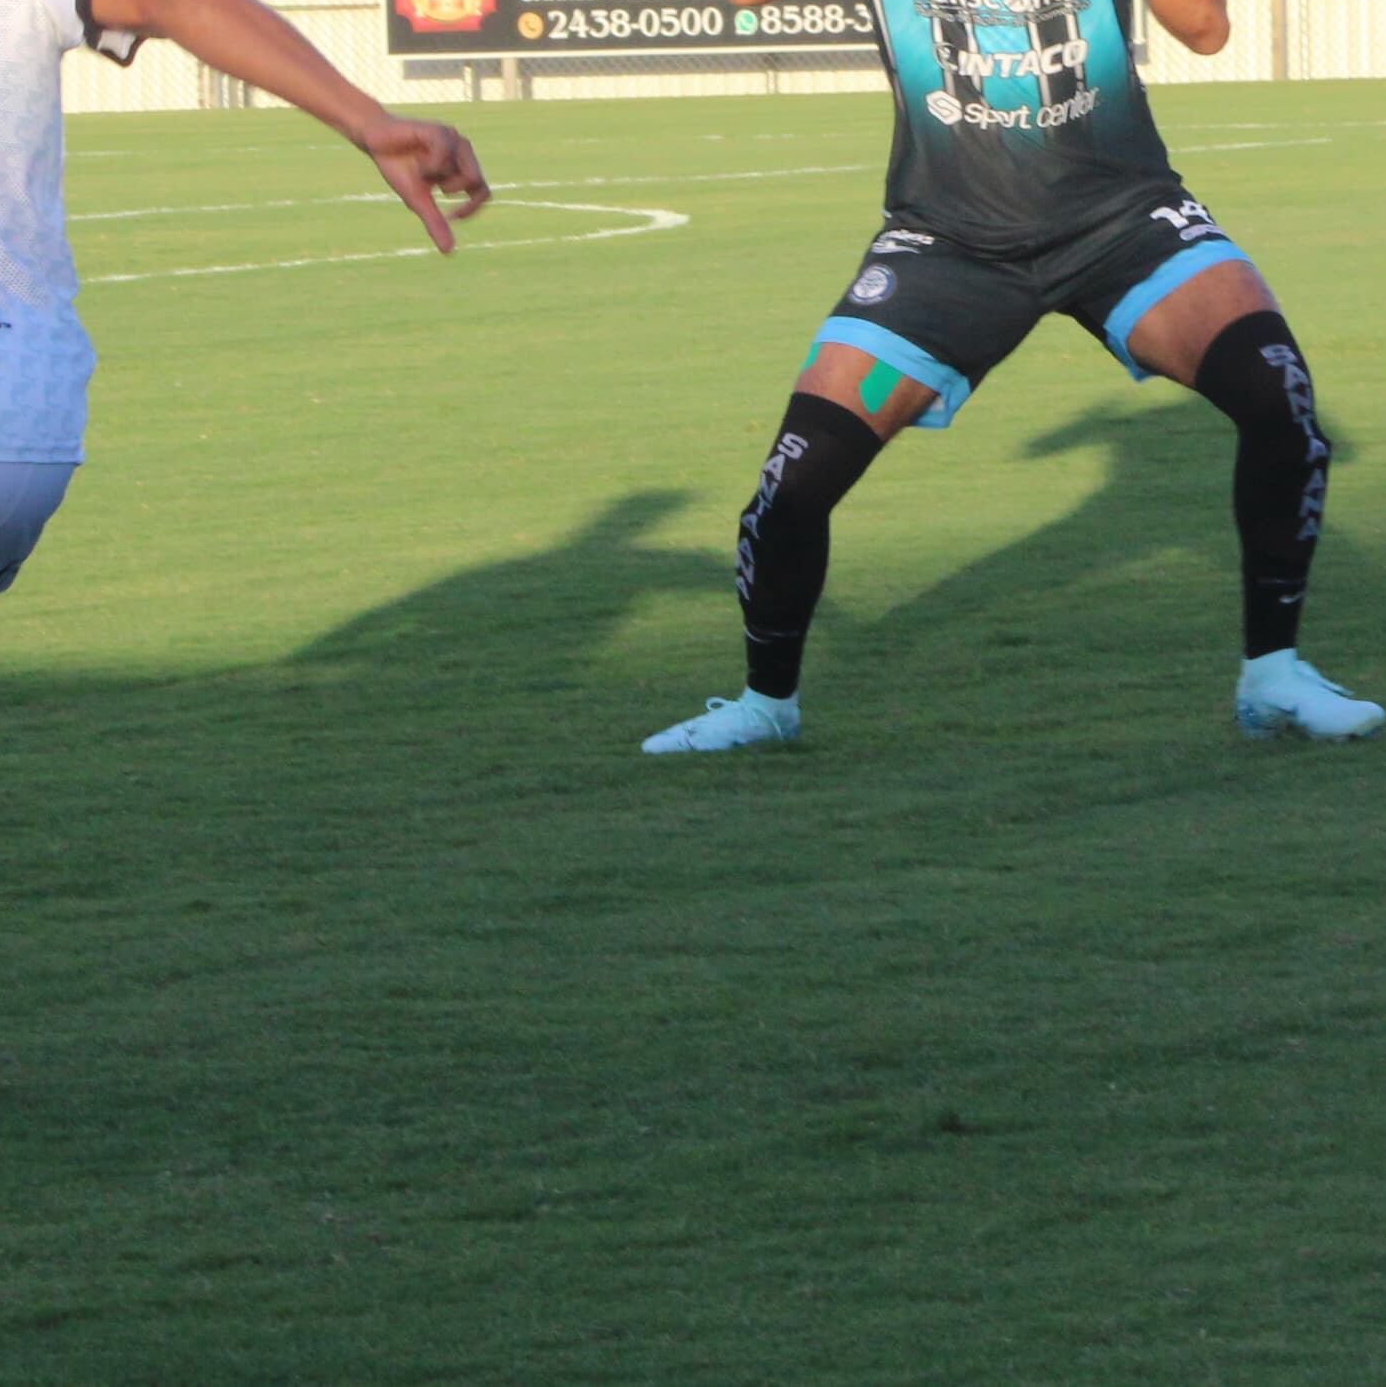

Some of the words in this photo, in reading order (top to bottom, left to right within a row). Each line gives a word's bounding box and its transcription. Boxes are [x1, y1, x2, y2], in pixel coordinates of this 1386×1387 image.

[548, 6, 724, 40] 2438-0500
[958, 38, 1088, 79] INTACO
[965, 102, 1032, 130] Sport
